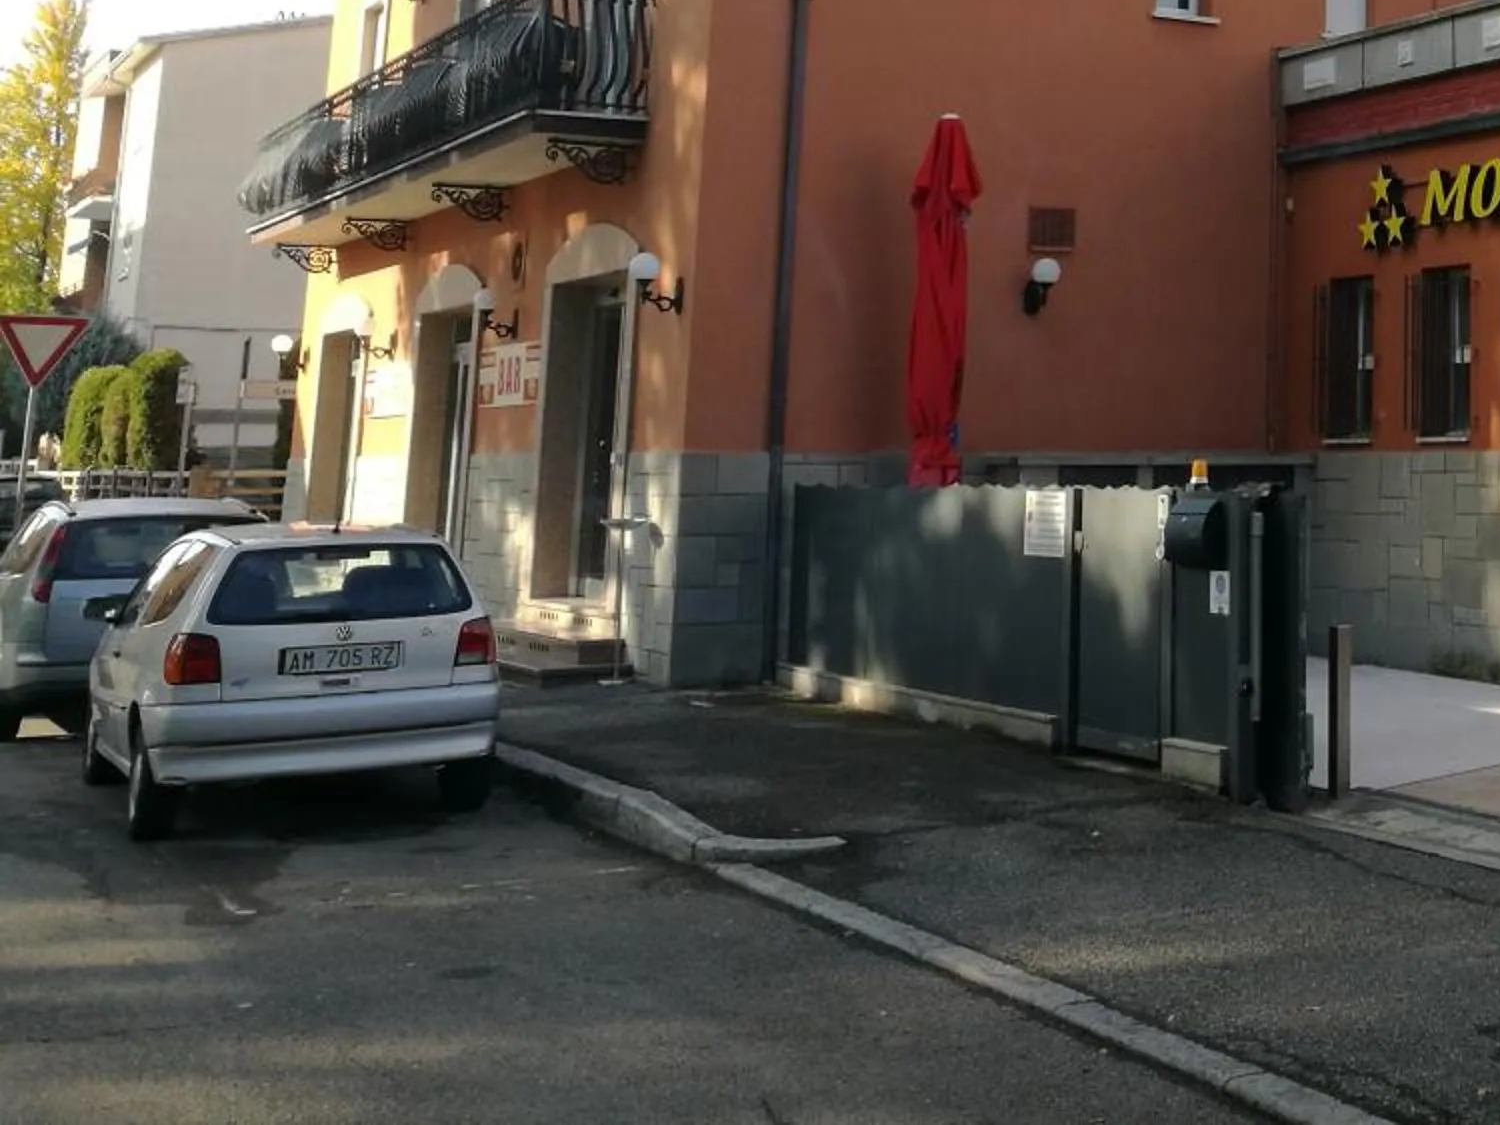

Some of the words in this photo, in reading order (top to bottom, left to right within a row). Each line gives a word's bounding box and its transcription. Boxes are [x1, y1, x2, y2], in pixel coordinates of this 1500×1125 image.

[497, 355, 521, 396] BAR
[289, 651, 314, 672] AM
[326, 649, 363, 669] 705
[371, 646, 395, 666] RZ
